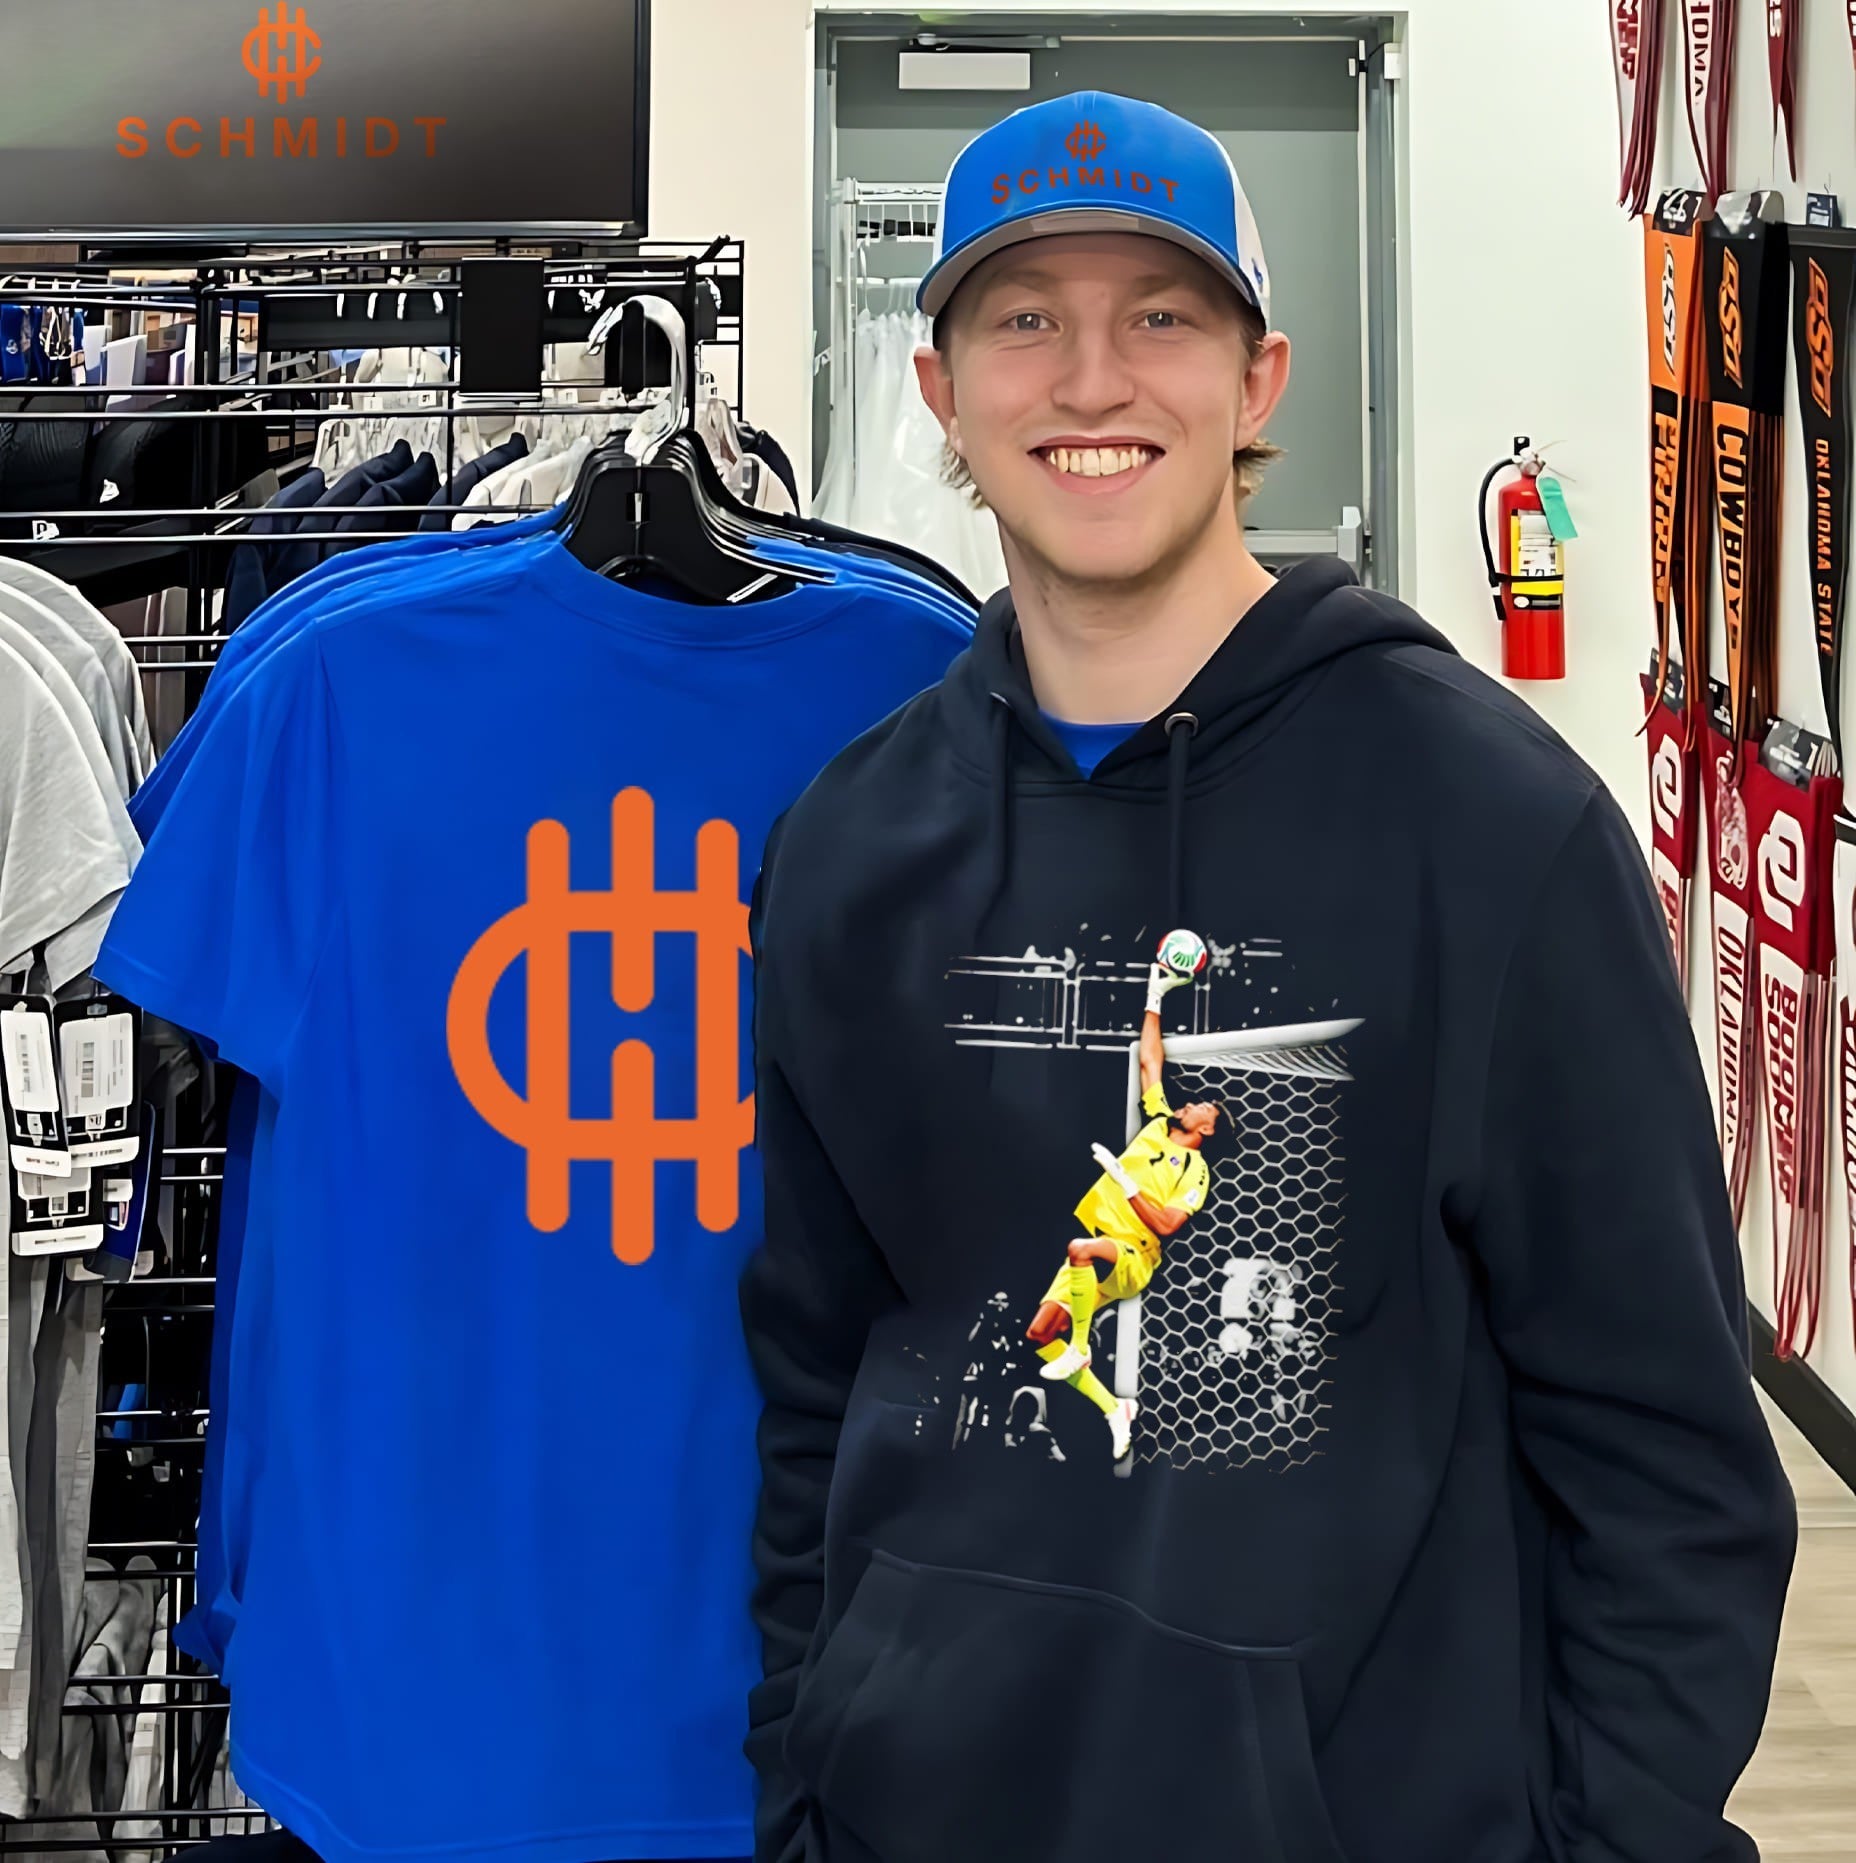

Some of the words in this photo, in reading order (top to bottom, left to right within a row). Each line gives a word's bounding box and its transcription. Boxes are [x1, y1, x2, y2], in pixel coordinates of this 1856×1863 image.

[115, 116, 447, 159] SCHMIDT
[991, 167, 1179, 204] SCHMIDT
[1815, 439, 1832, 571] OKLAHOMA
